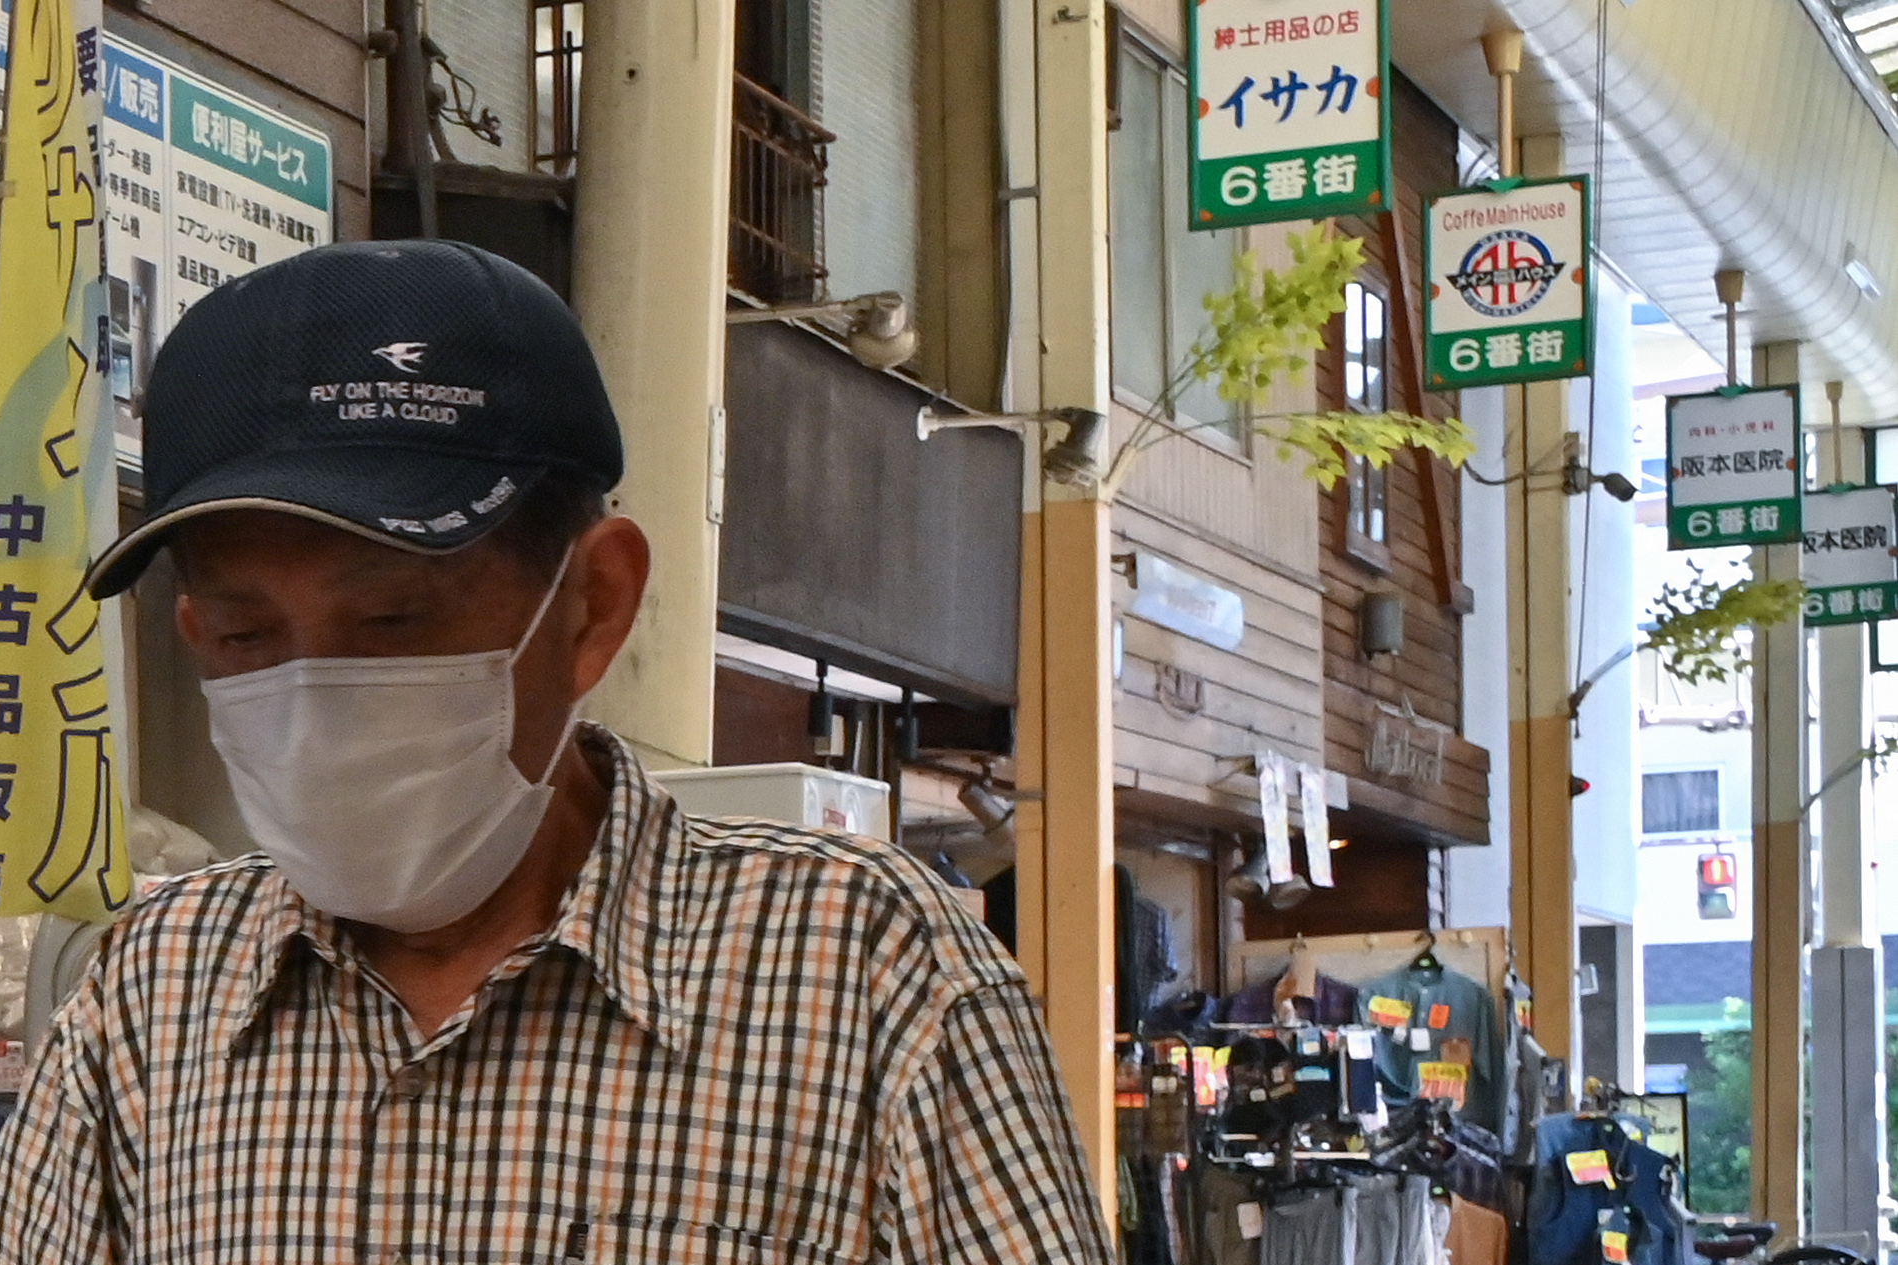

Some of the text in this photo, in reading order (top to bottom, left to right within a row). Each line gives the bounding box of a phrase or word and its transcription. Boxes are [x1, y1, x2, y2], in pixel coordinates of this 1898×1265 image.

[1214, 10, 1360, 49] 紳士用品の店
[1218, 64, 1359, 129] イサカ
[191, 100, 308, 186] 便利屋サービス
[1220, 154, 1357, 206] 6番街
[1449, 330, 1564, 372] 6番街
[310, 381, 485, 406] FLY ON THE HORIZON
[338, 402, 458, 424] LIKE A CLOUD
[1680, 449, 1784, 477] 阪本医院
[1687, 505, 1780, 537] 6番街
